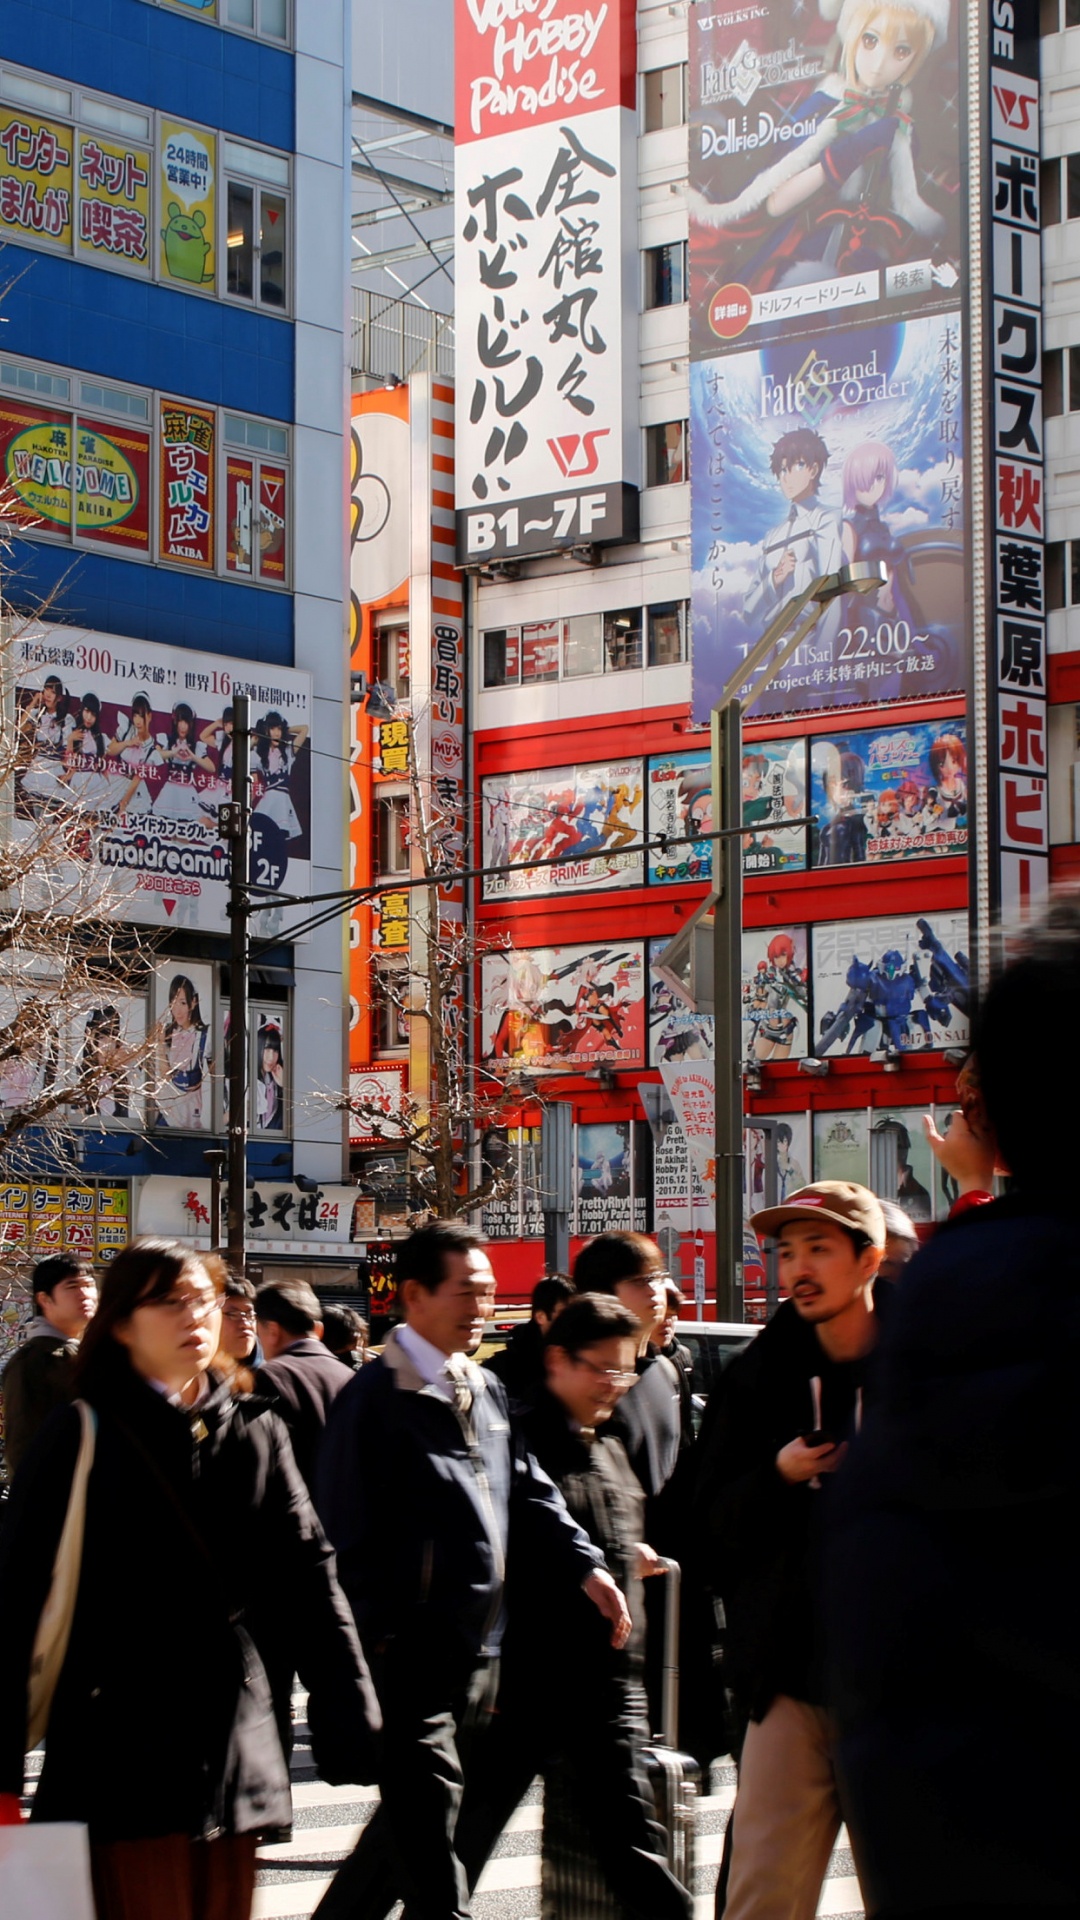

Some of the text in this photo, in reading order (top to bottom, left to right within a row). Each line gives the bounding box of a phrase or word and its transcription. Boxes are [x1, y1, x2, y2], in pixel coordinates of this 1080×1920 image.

[717, 13, 750, 27] VOLKS
[750, 6, 770, 19] INC.
[742, 38, 796, 69] Grand
[701, 60, 824, 98] Fate Order
[470, 55, 606, 134] Paradise
[167, 144, 208, 171] 24時間
[0, 176, 147, 259] まんが喫茶
[535, 126, 617, 416] 全館丸々
[892, 268, 925, 290] 検索
[714, 303, 747, 321] 詳細は
[758, 281, 867, 316] ドルフィードリーム
[805, 350, 881, 387] Grand
[760, 373, 910, 418] Fate Order
[938, 328, 961, 531] 未来を取り戻す
[14, 449, 132, 501] WELCOME
[78, 453, 114, 467] PARADISE
[705, 372, 727, 591] すべてはここから
[78, 501, 112, 518] AKIBA
[168, 543, 204, 561] AKIBA
[434, 625, 460, 724] 買取り
[101, 838, 233, 878] maidreamin
[256, 857, 280, 886] 2F
[655, 860, 711, 880] キャラグミ
[944, 1027, 969, 1042] SAL
[319, 1219, 338, 1232] 時間
[320, 1203, 339, 1219] 24
[581, 1208, 608, 1221] Hobby
[610, 1208, 646, 1220] Paraise
